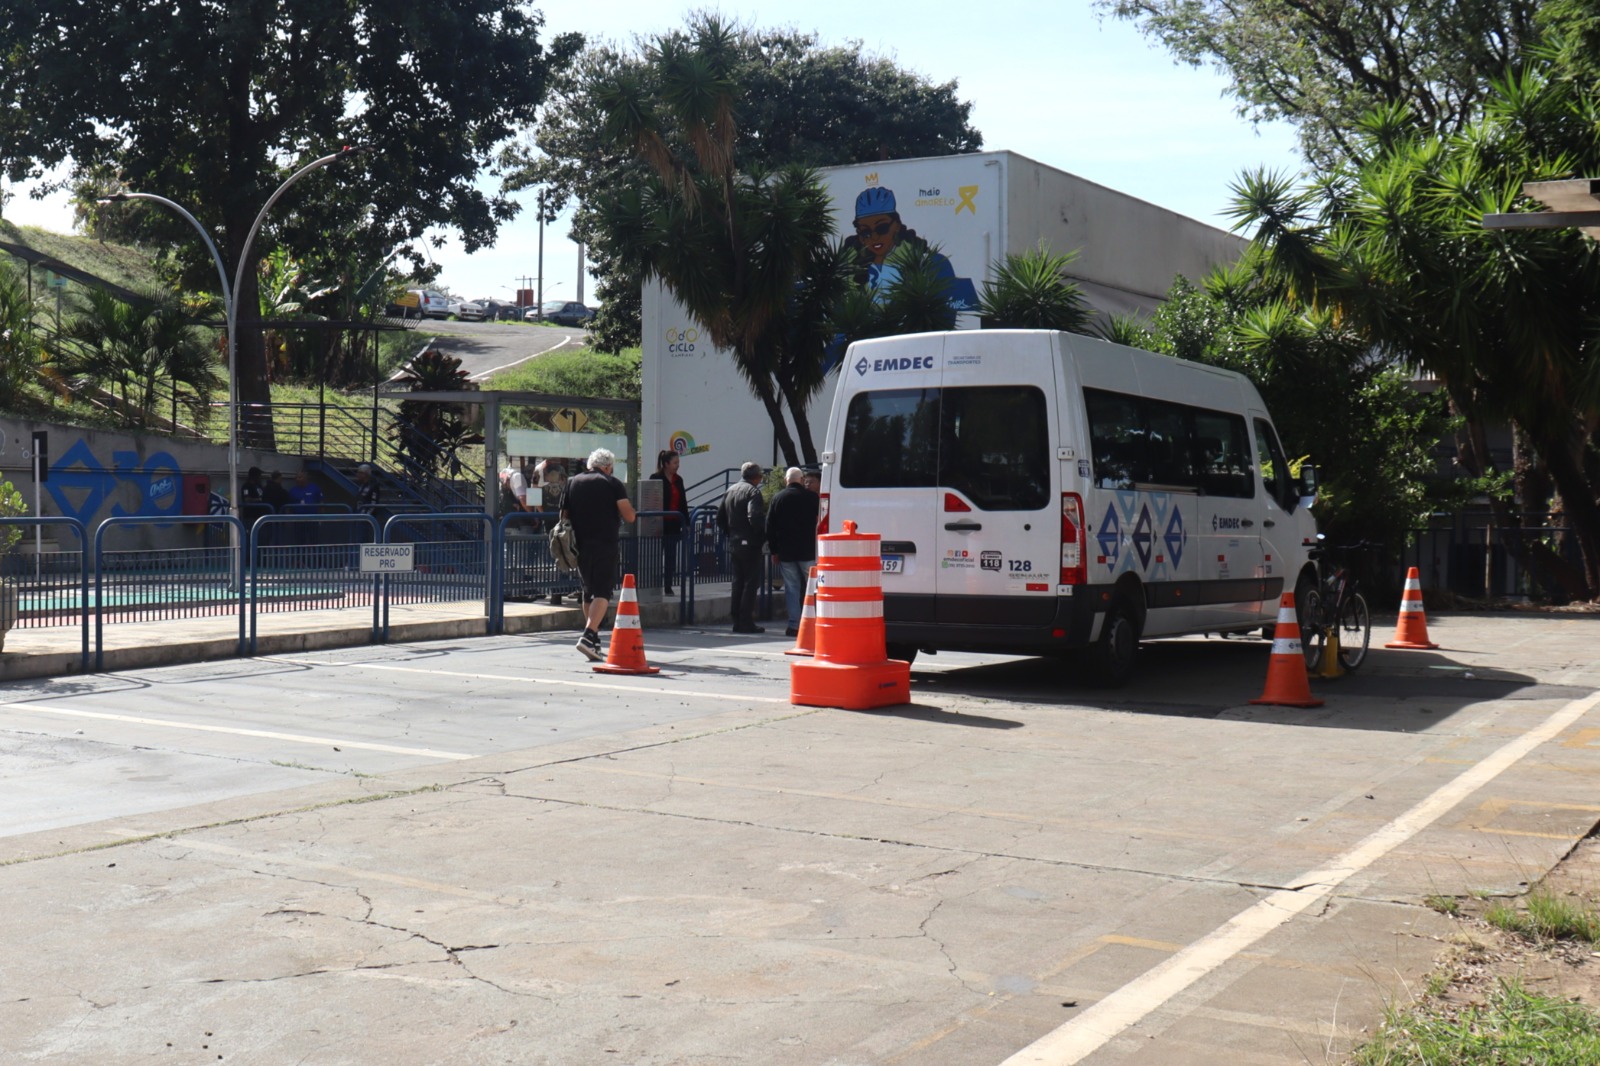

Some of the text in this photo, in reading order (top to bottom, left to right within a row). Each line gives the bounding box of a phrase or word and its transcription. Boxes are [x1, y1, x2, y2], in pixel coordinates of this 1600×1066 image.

[919, 187, 940, 197] maio
[668, 343, 695, 352] CICLO
[873, 356, 934, 371] EMDEC
[1219, 517, 1240, 529] EMDEC
[364, 547, 410, 557] RESERVADO
[379, 559, 396, 568] PRG
[983, 559, 1000, 567] 118
[1008, 560, 1032, 572] 128
